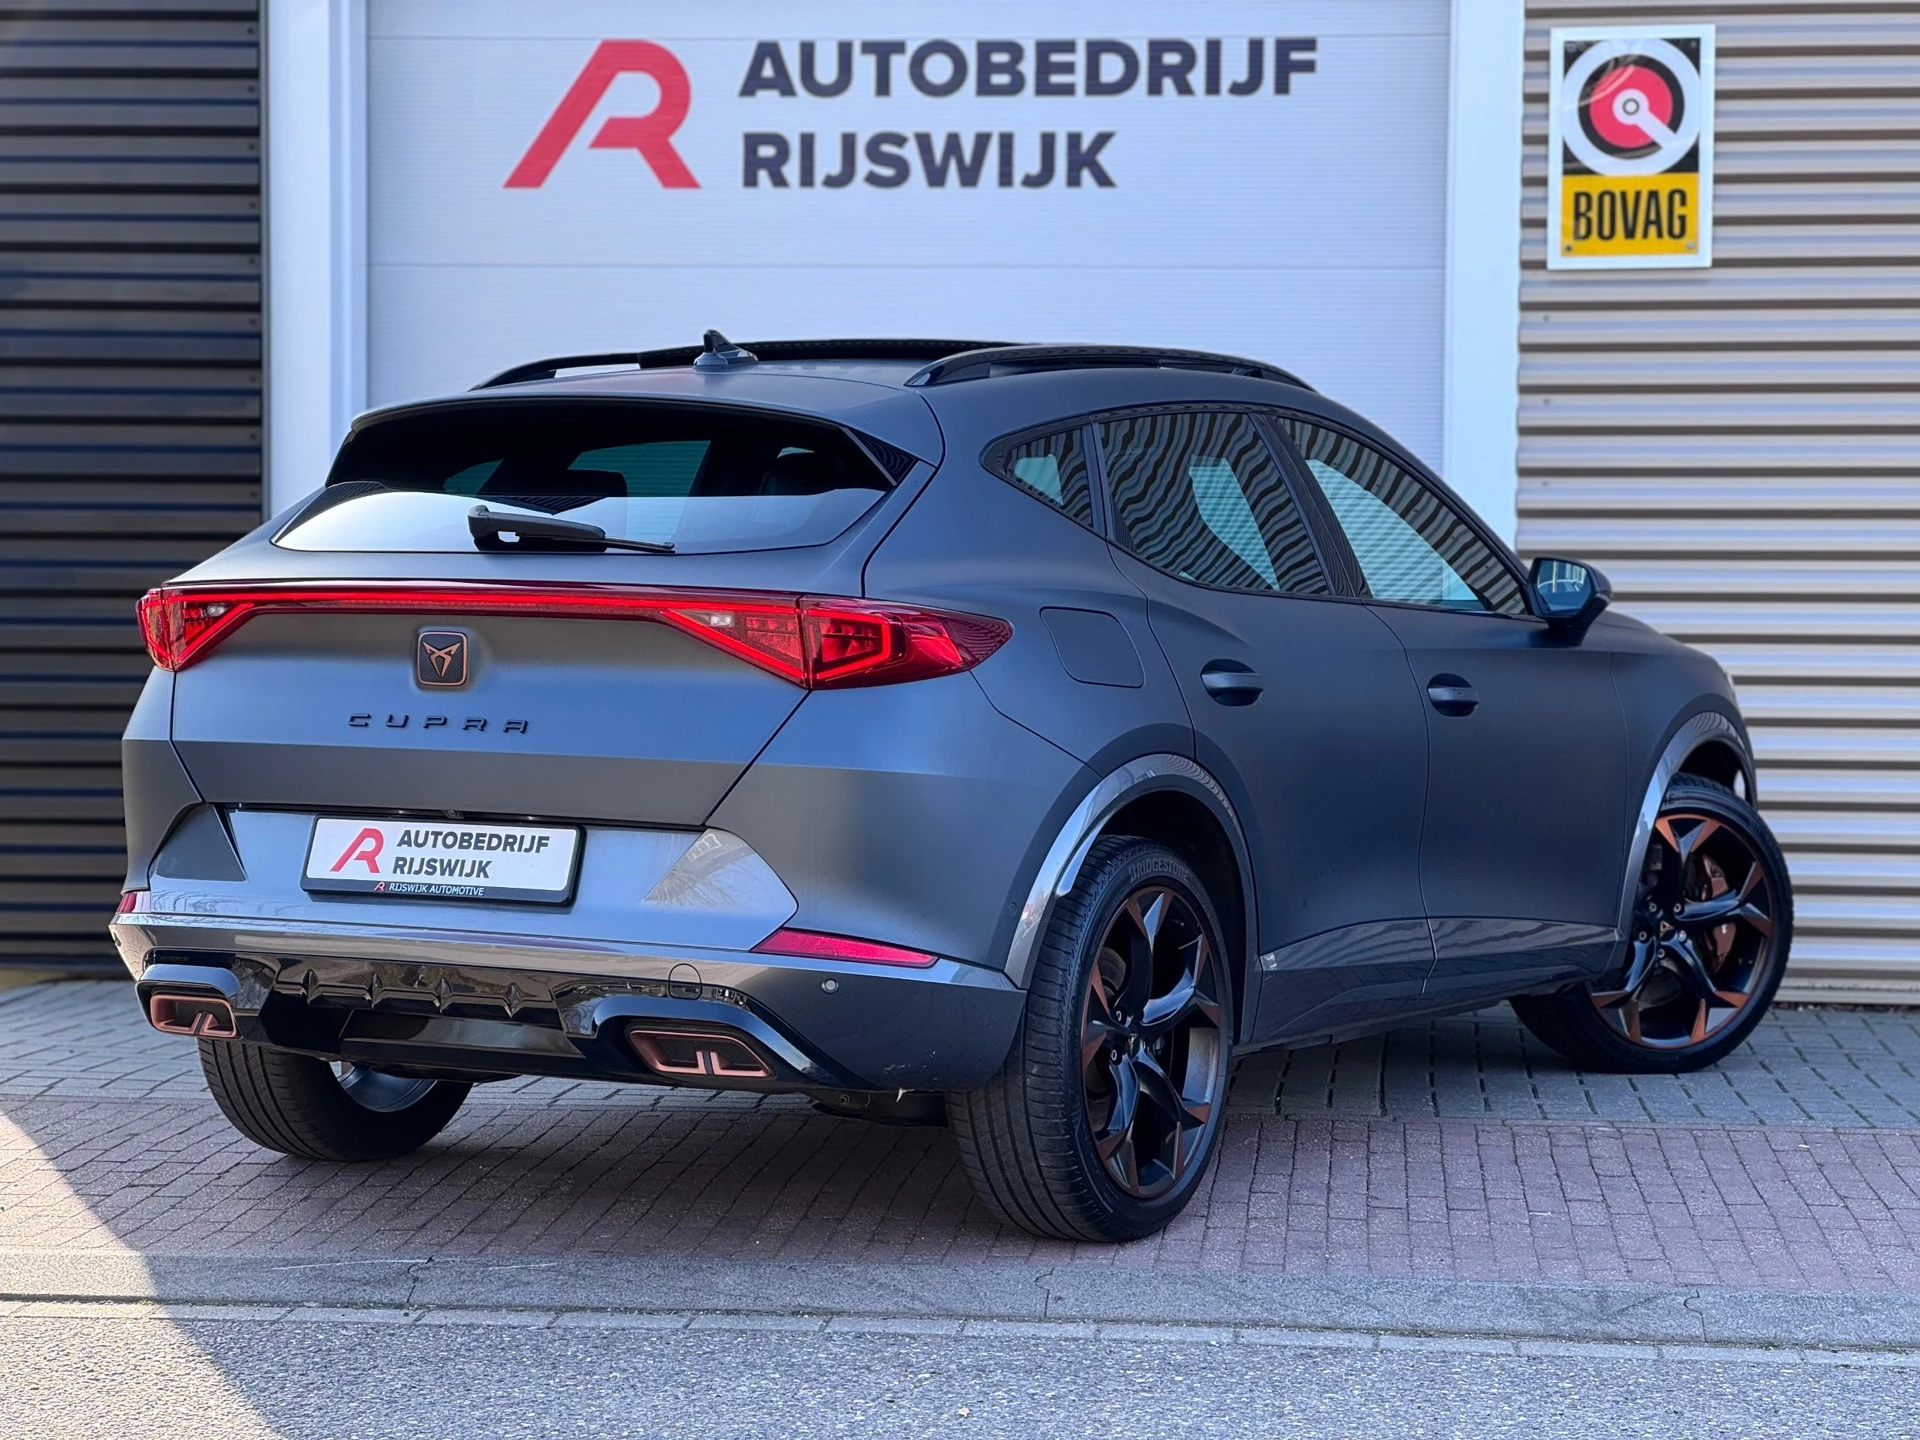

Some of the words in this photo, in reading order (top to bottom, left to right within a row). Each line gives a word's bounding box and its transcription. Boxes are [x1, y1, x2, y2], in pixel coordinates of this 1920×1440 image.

[738, 37, 1318, 97] AUTOBEDRIJF
[741, 130, 1117, 189] RIJSWIJK
[1573, 188, 1688, 241] BOVAG
[347, 713, 529, 734] CUPRA
[396, 829, 551, 854] AUTOBEDRIJF
[392, 856, 493, 879] RIJSWIJK
[1128, 858, 1191, 883] BRIDGESTONE
[389, 882, 428, 894] RIJSWIJK
[429, 885, 485, 896] AUTOMOTIVE
